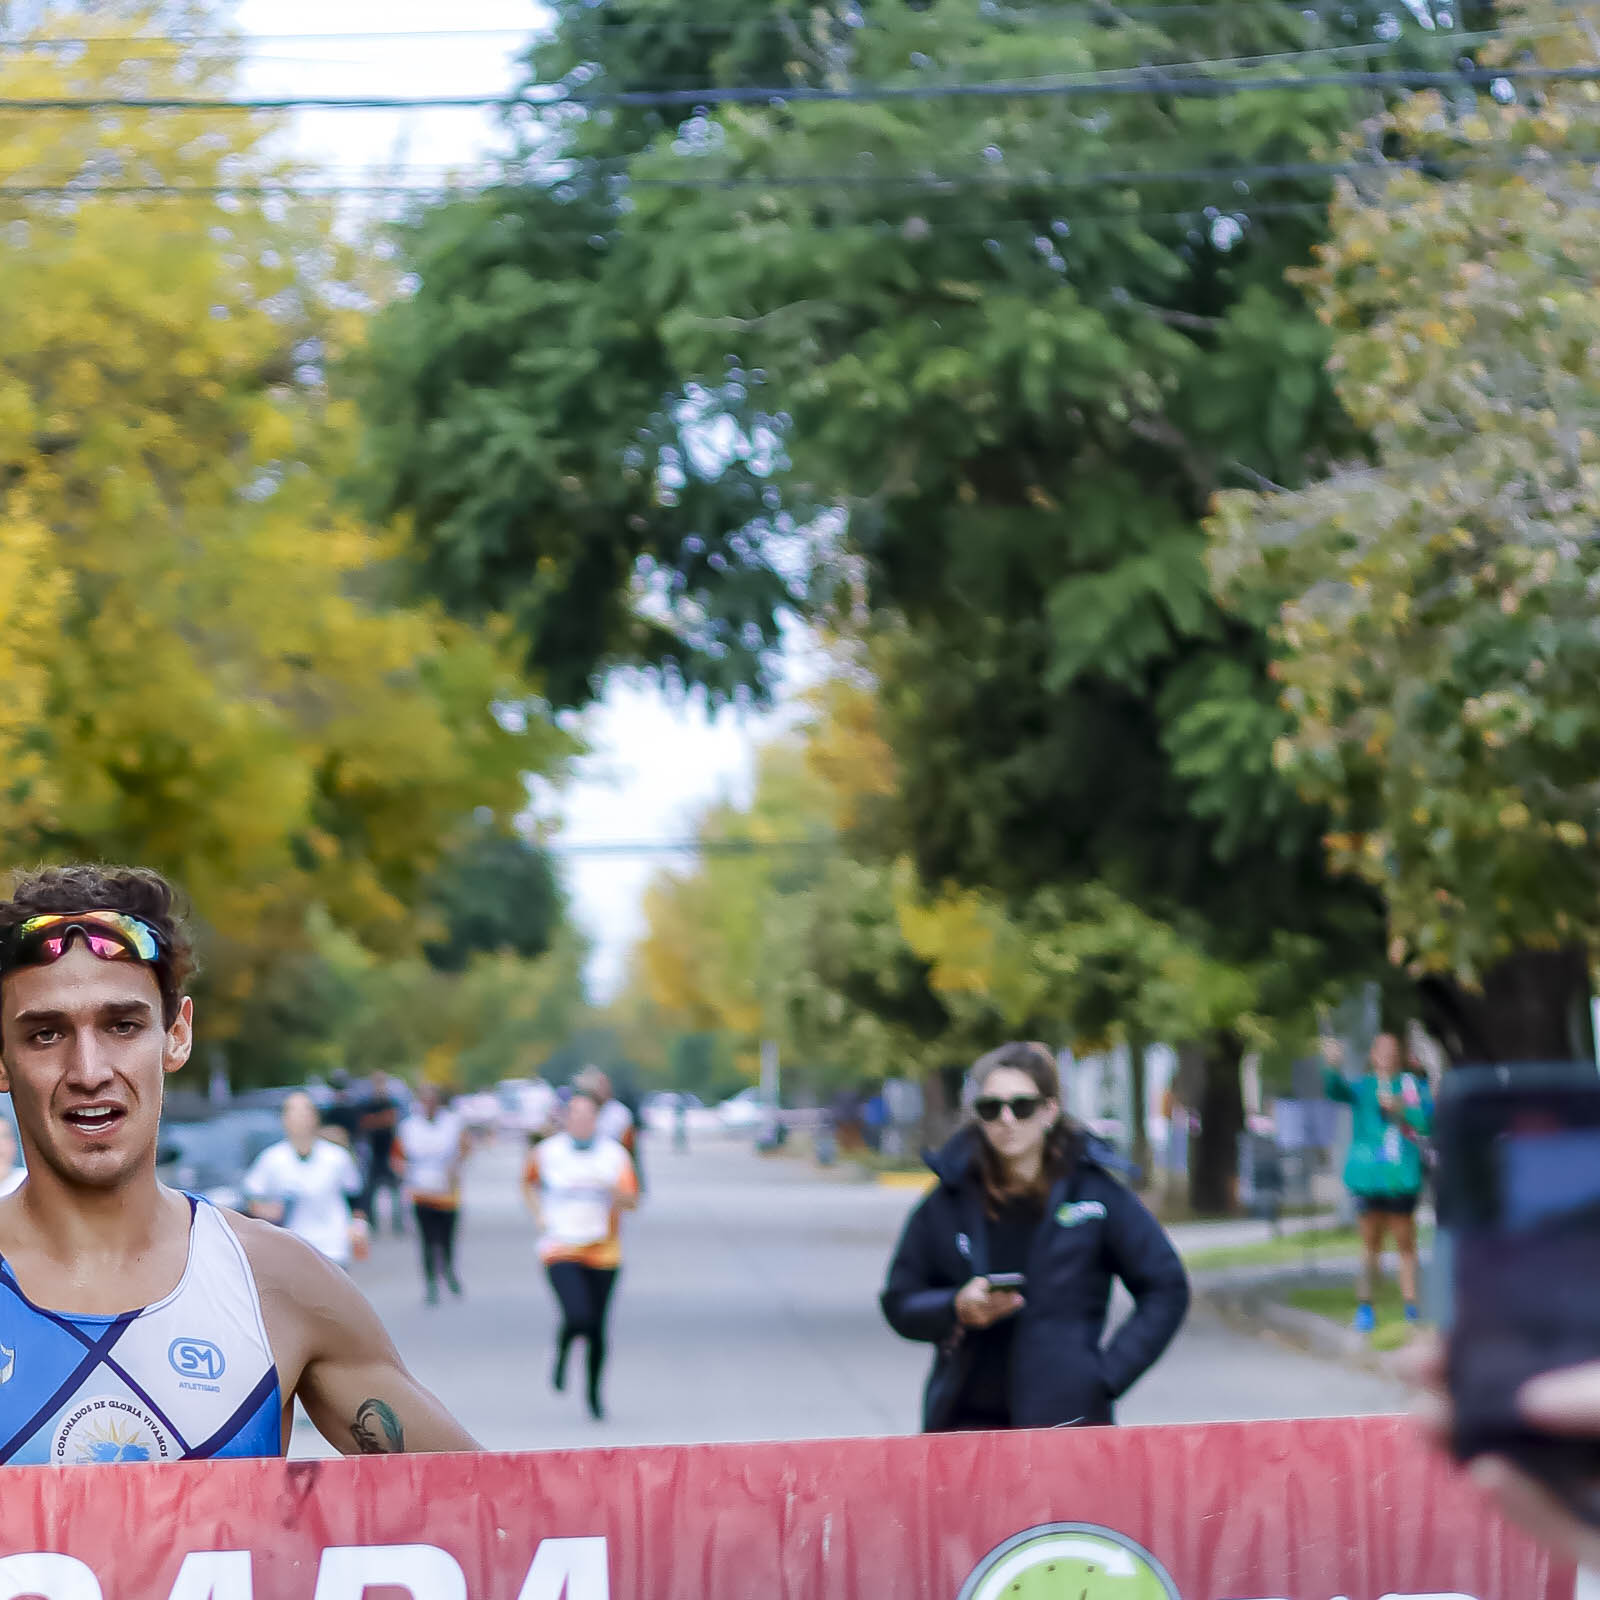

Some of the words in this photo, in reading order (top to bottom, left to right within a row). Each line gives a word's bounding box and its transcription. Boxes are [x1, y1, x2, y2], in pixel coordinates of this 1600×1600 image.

[57, 1405, 92, 1456] CORONADOS
[93, 1401, 106, 1410] DE
[108, 1401, 142, 1418] GLORIA
